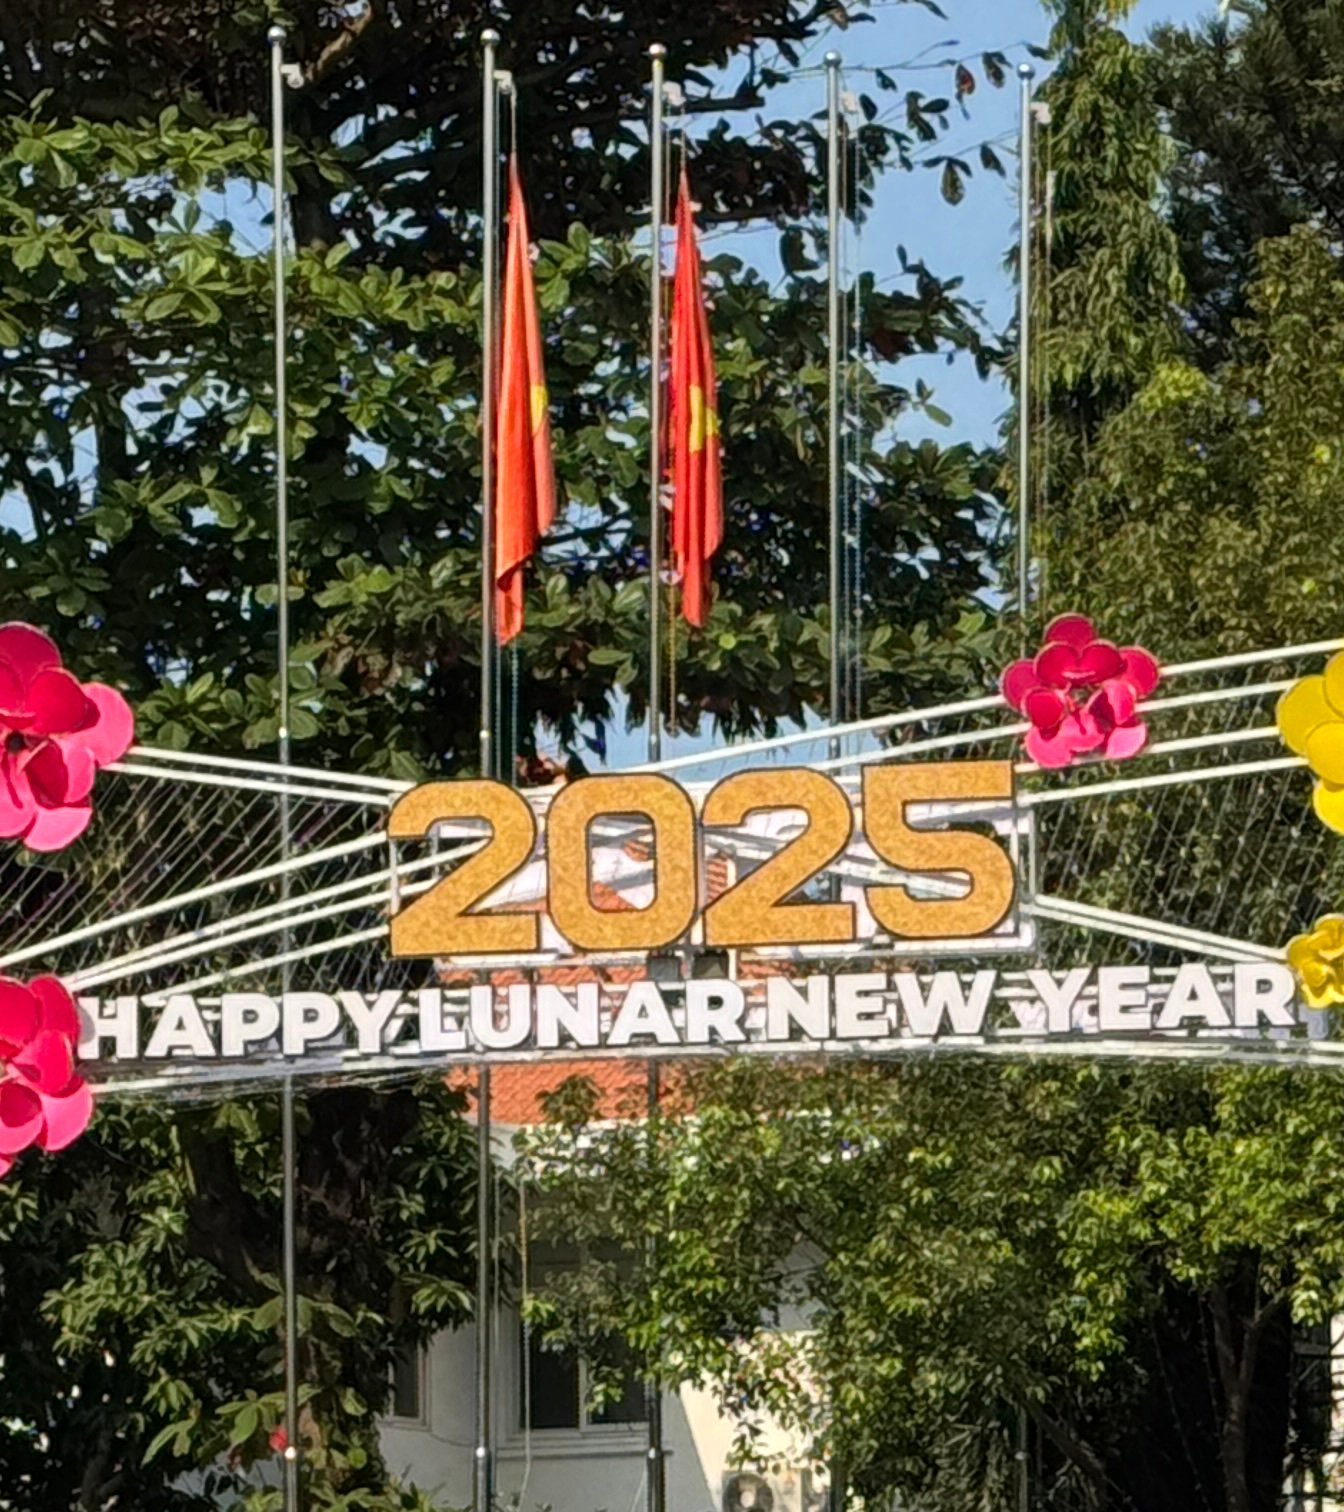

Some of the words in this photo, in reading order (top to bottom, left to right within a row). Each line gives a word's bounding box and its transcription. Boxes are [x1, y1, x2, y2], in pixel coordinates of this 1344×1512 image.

[387, 759, 1016, 957] 2025
[78, 989, 402, 1060] HAPPY
[416, 978, 748, 1053] LUNAR
[765, 969, 998, 1040] NEW
[1026, 962, 1297, 1033] YEAR
